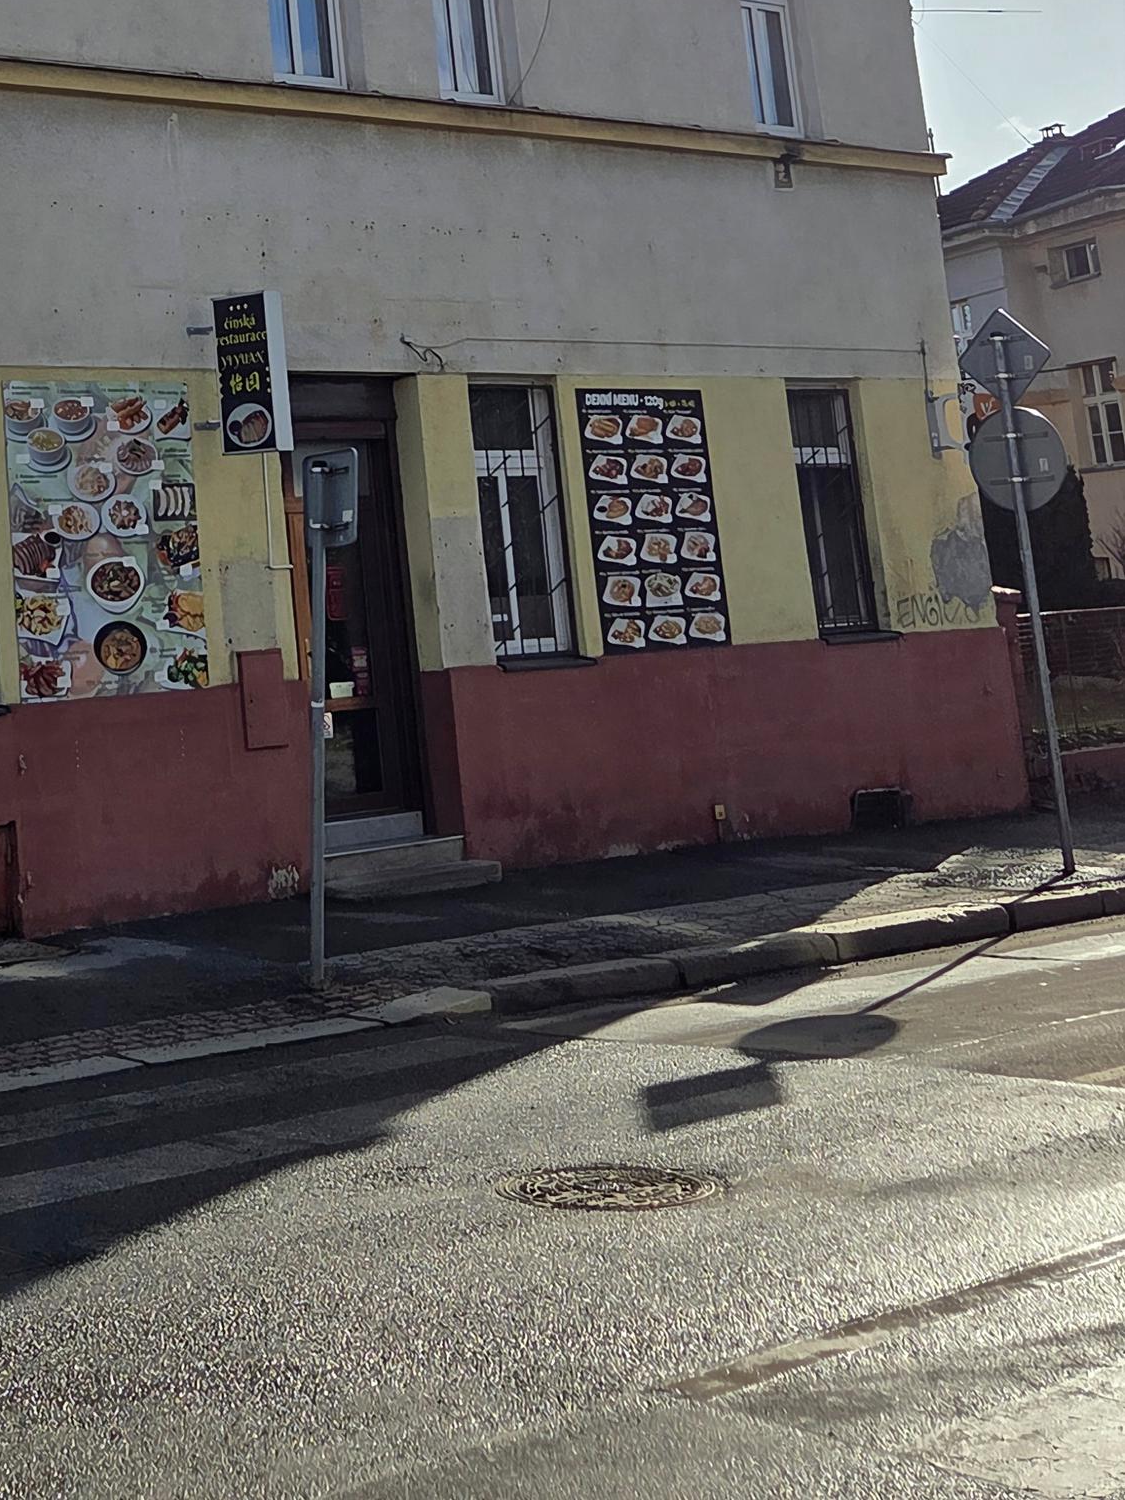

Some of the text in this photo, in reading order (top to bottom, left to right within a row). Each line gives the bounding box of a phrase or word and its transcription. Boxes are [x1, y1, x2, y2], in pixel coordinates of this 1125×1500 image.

[224, 313, 256, 329] čínská
[585, 391, 612, 406] DENNÍ
[613, 393, 639, 406] MENU
